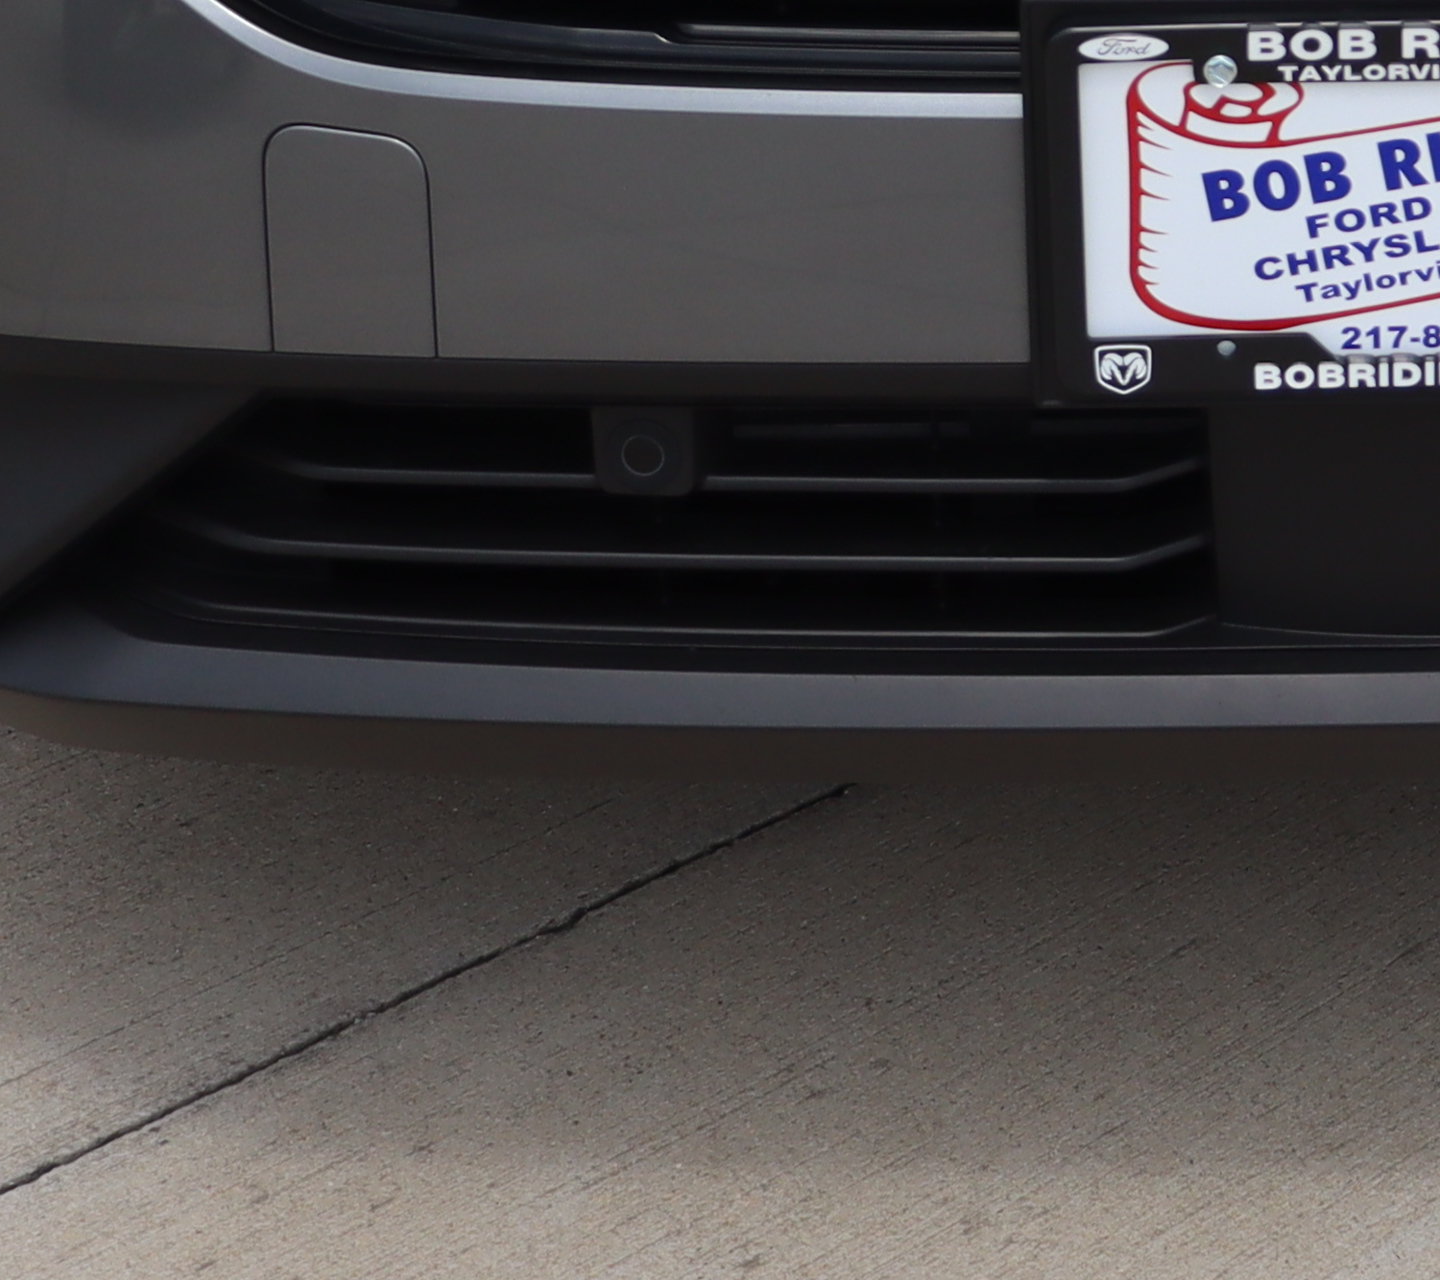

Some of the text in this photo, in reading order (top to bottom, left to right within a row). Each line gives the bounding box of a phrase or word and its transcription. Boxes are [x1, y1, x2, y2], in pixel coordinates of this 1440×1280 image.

[1097, 38, 1151, 56] Ford
[1247, 27, 1378, 62] BOB
[1201, 151, 1352, 222] BOB
[1305, 197, 1432, 238] FORD
